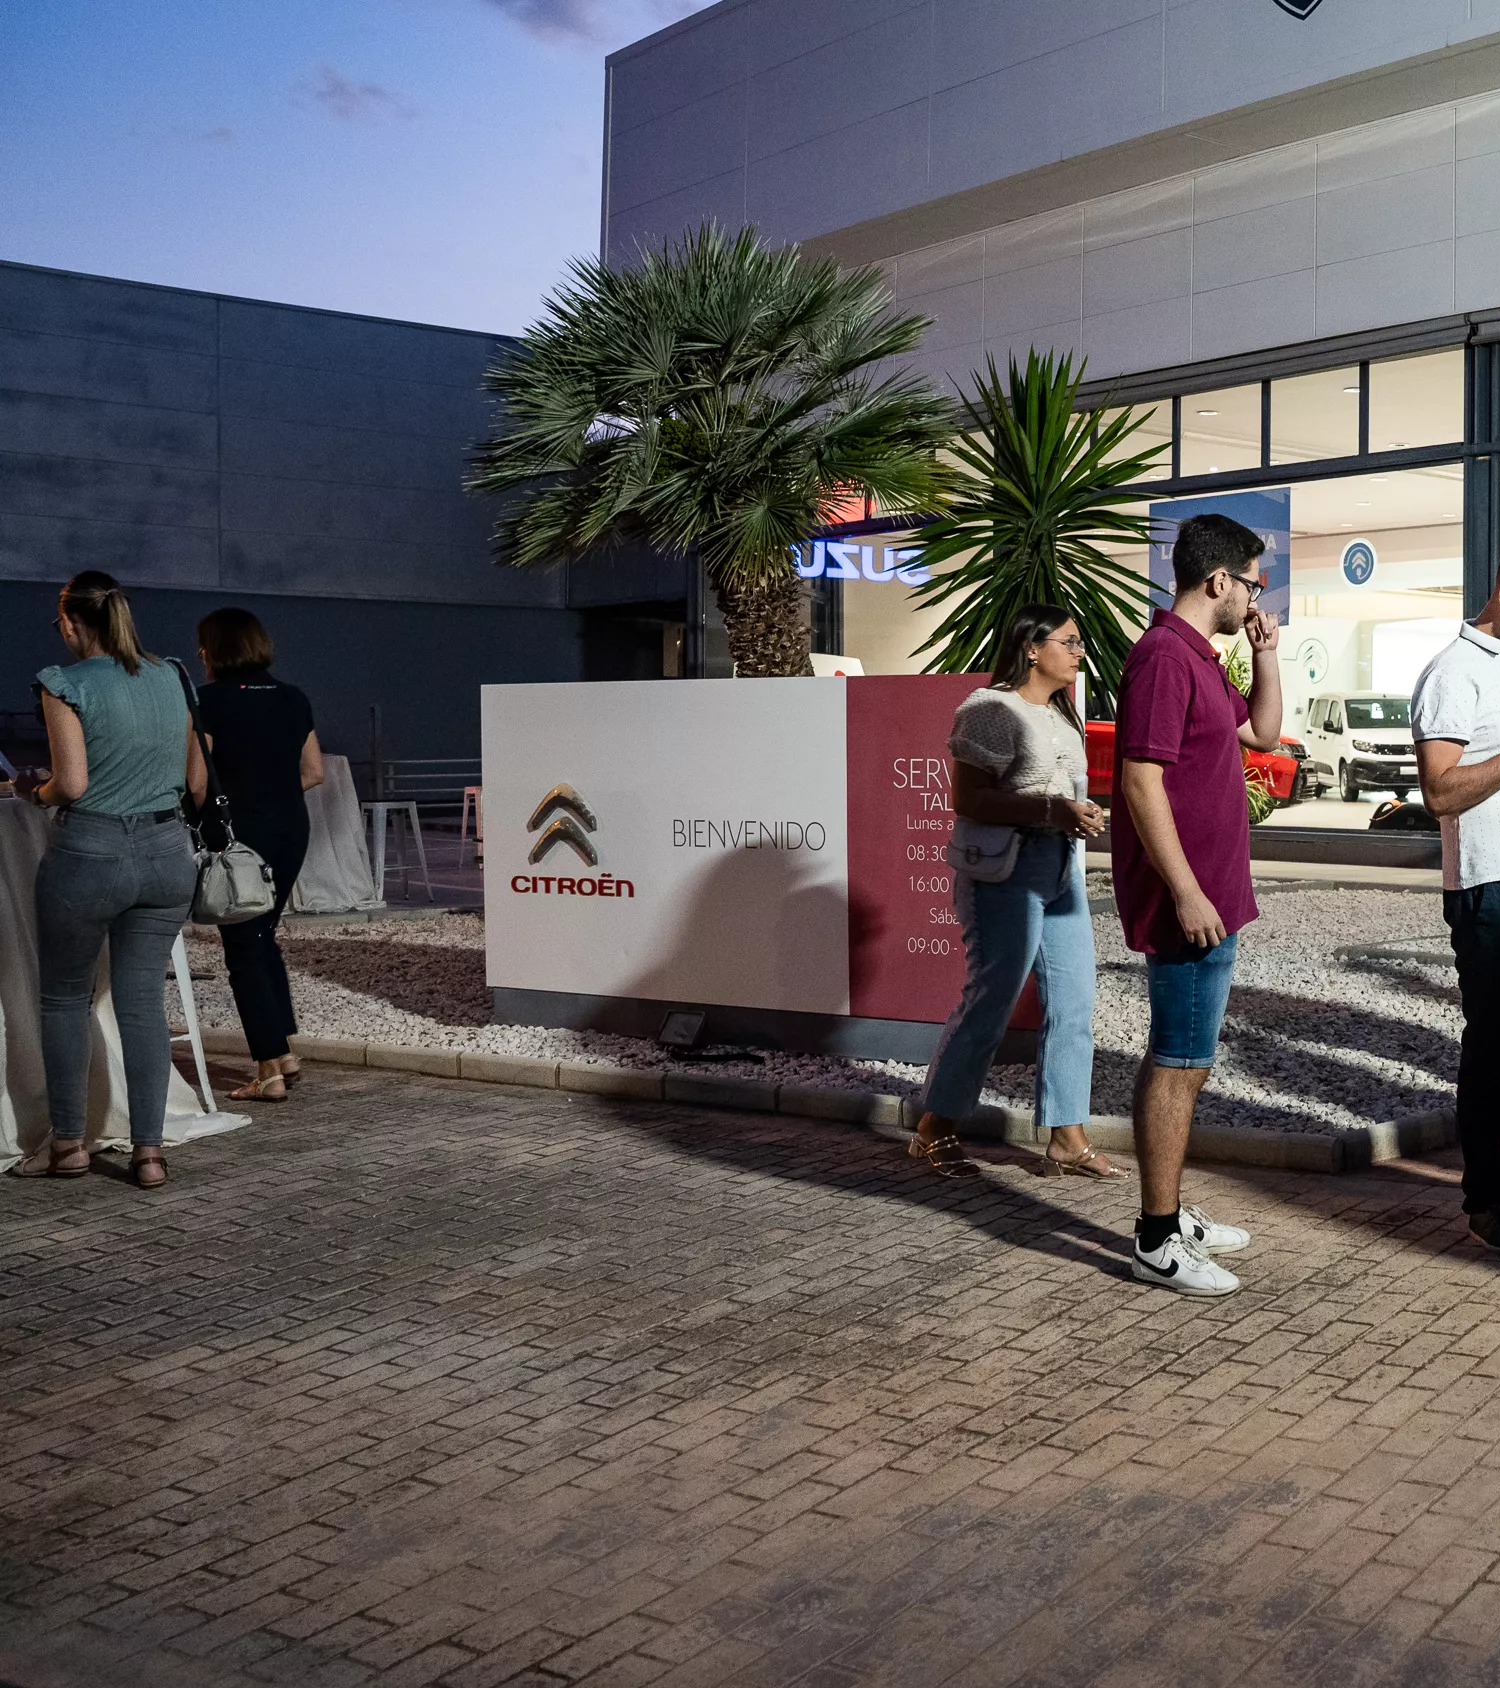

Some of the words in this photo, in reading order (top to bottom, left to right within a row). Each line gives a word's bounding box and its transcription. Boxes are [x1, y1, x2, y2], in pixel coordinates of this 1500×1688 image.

[907, 814, 943, 831] Lunes
[672, 819, 826, 851] BIENVENIDO
[908, 876, 950, 893] 16:00
[907, 937, 950, 956] 09:00
